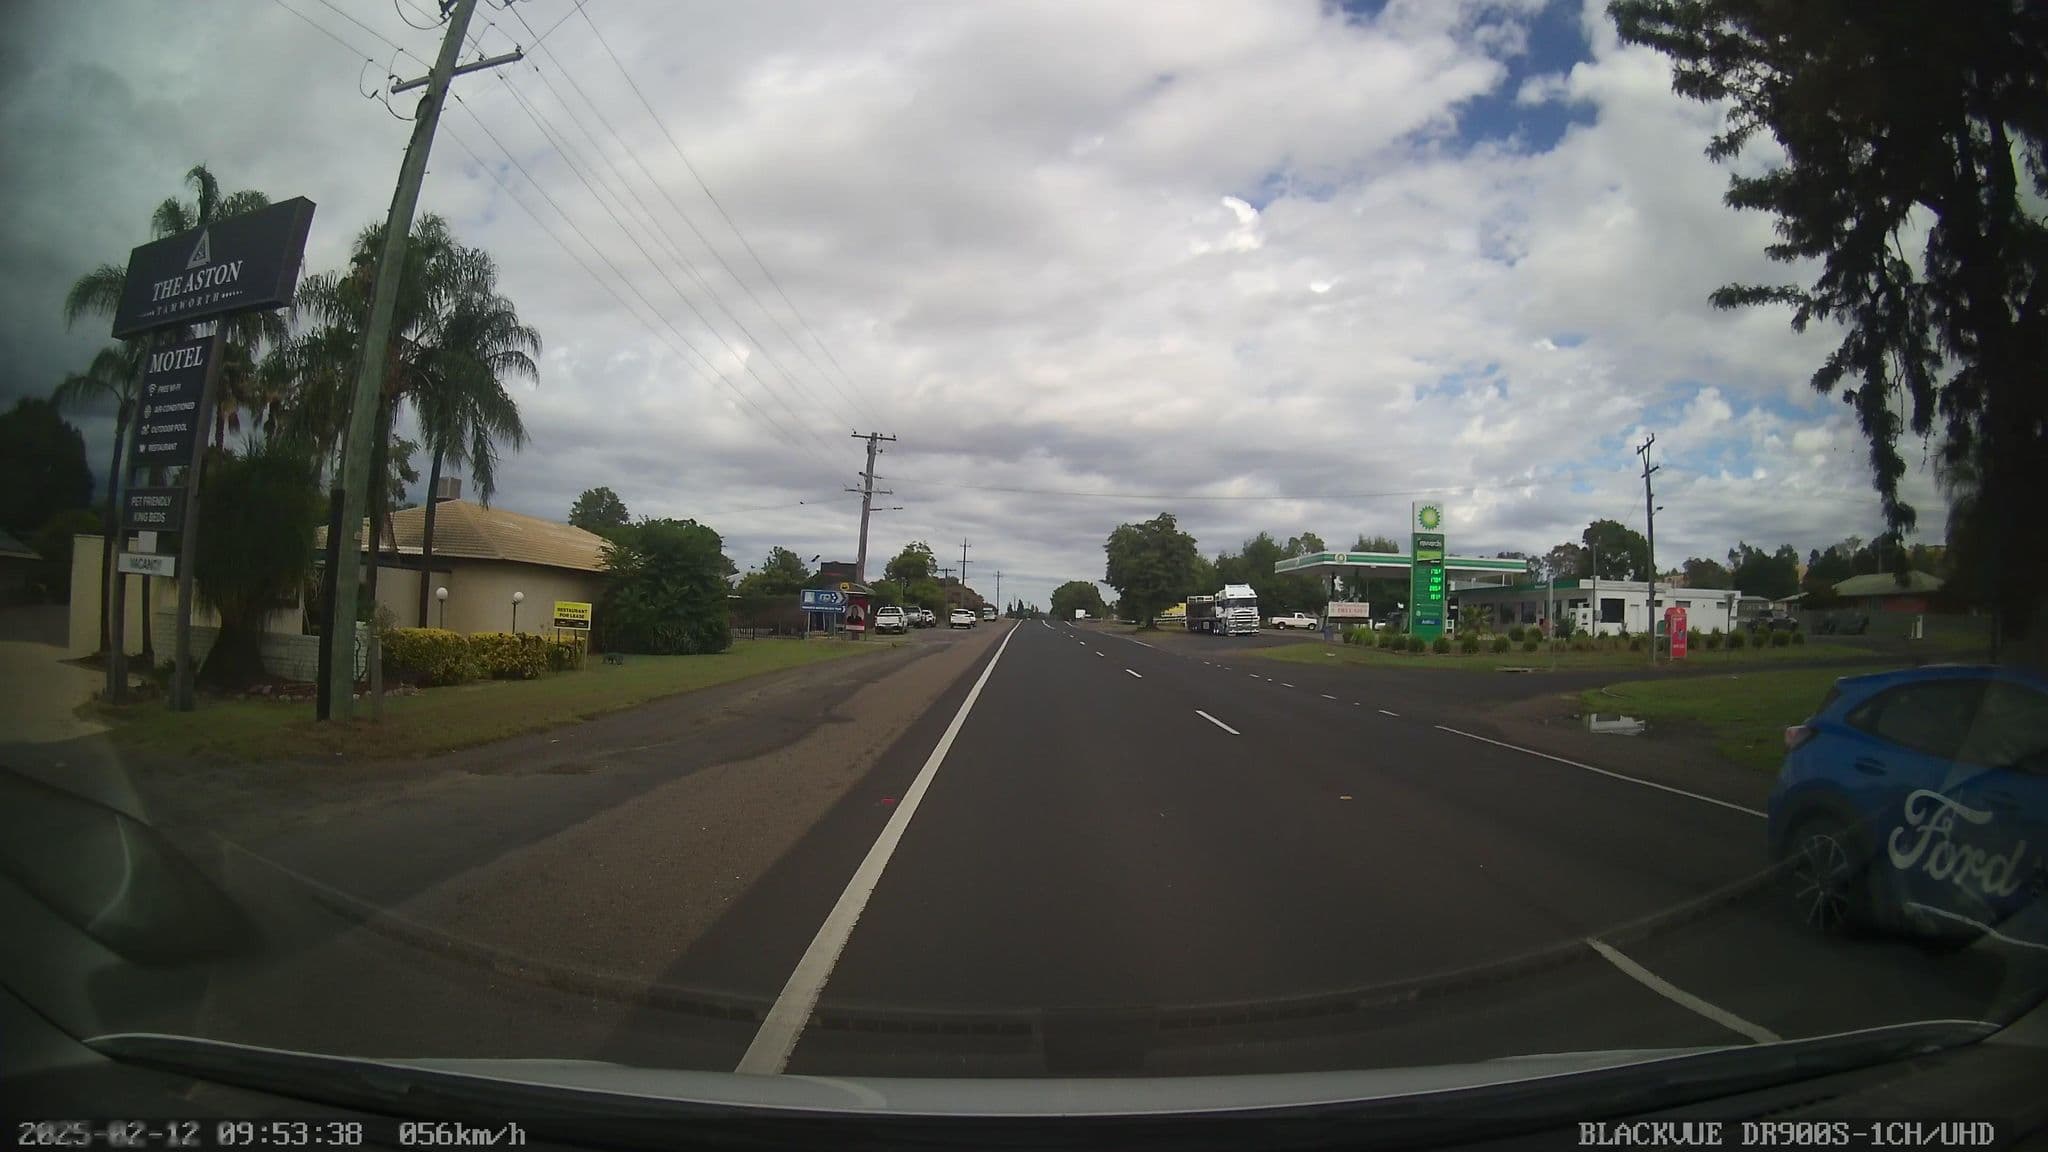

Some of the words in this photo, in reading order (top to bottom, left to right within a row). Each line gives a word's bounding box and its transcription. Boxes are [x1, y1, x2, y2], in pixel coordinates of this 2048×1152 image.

[152, 276, 183, 302] THE
[183, 260, 243, 294] ASTON
[157, 292, 220, 315] TAMWORTH
[149, 345, 203, 374] MOTEL
[150, 424, 174, 434] OUTDOOR
[174, 423, 187, 433] POOL
[148, 442, 178, 453] RESTAURANT
[131, 496, 143, 507] PET
[143, 495, 172, 507] FRIENDLY
[134, 512, 148, 522] KING
[148, 512, 166, 523] BEDS
[1888, 789, 2027, 898] Ford
